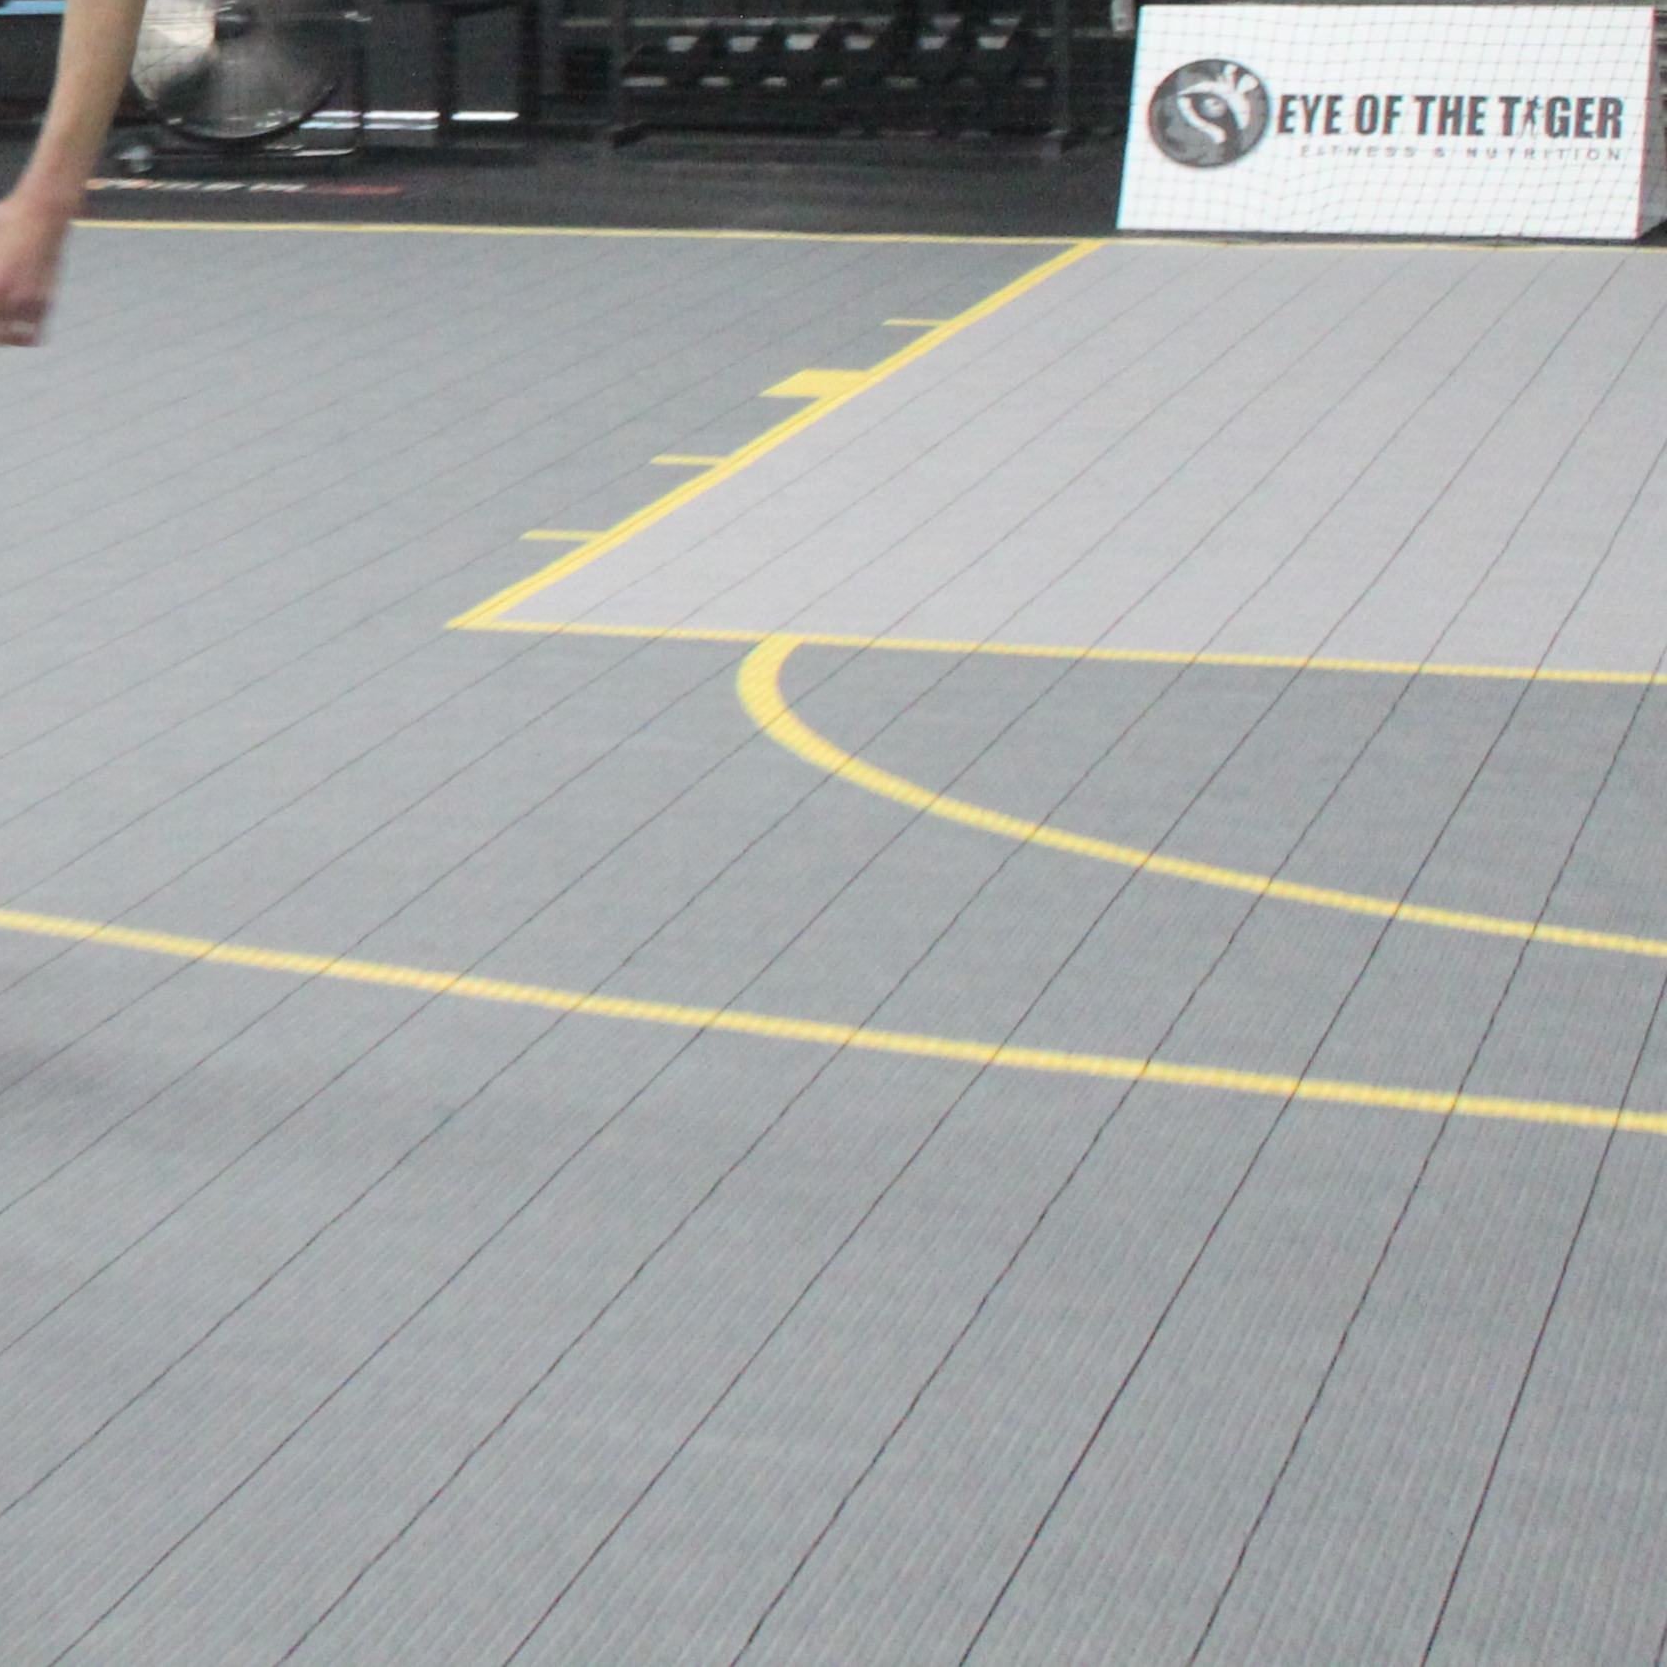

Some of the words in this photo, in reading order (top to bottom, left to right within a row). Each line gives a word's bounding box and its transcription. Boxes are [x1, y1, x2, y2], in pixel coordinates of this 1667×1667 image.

[1277, 94, 1343, 135] EYE
[1354, 94, 1403, 136] OF
[1413, 95, 1488, 137] THE
[1499, 95, 1624, 139] TIGER
[1300, 144, 1417, 158] FITNESS
[1433, 146, 1446, 158] &
[1467, 147, 1621, 161] NUTRITION
